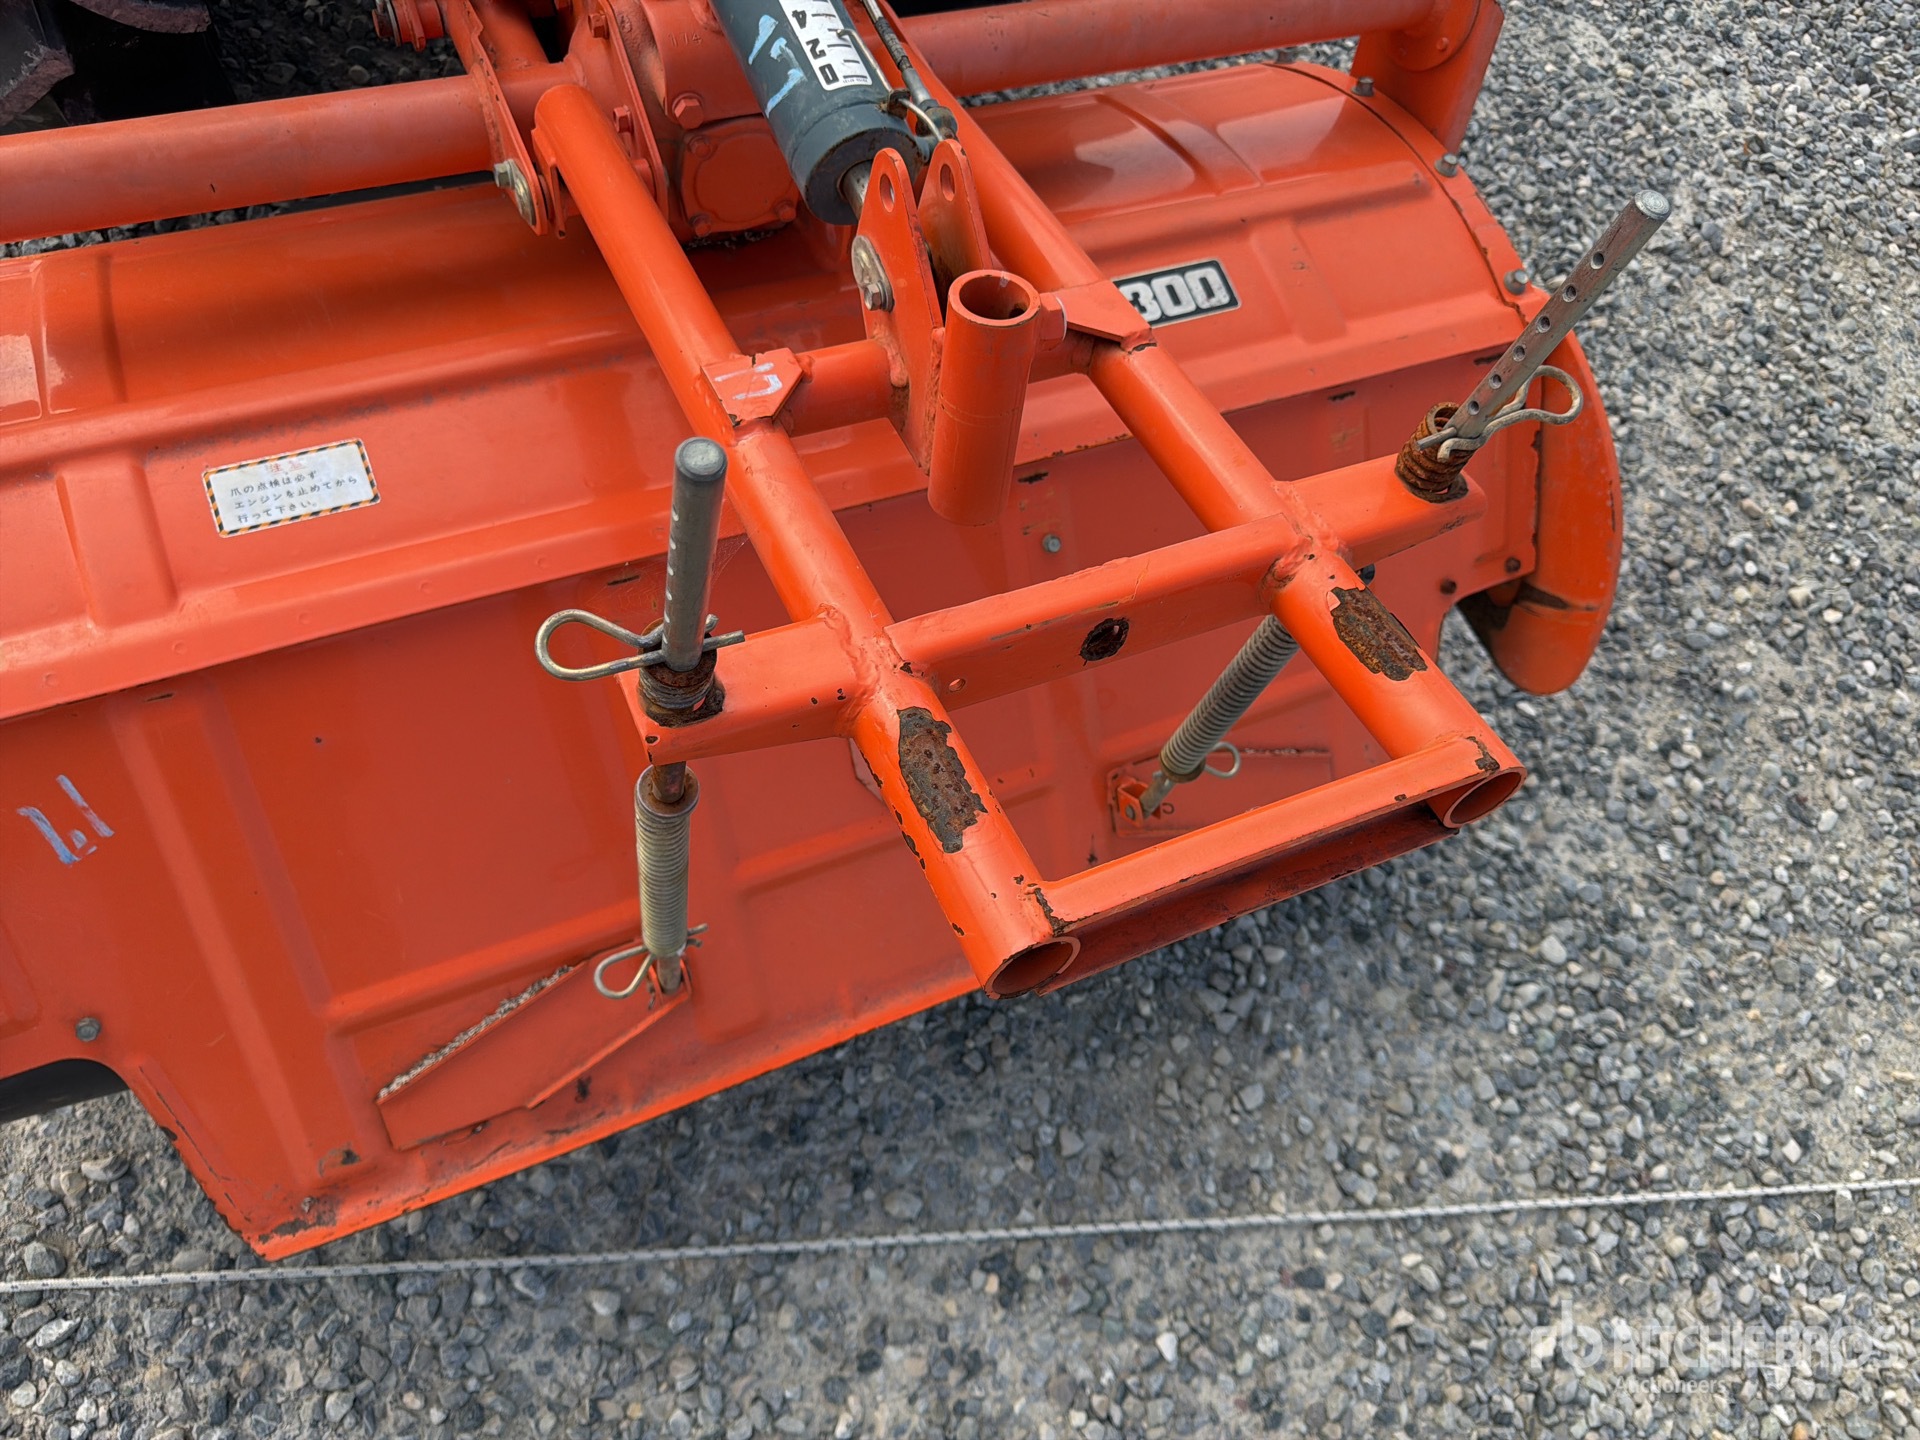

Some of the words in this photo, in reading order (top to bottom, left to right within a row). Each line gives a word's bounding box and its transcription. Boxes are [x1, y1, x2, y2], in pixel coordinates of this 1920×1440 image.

[792, 10, 807, 29] 4
[805, 38, 827, 60] 2
[818, 63, 840, 85] 0
[1118, 266, 1231, 322] 300
[234, 476, 358, 509] エンジンを止めてから
